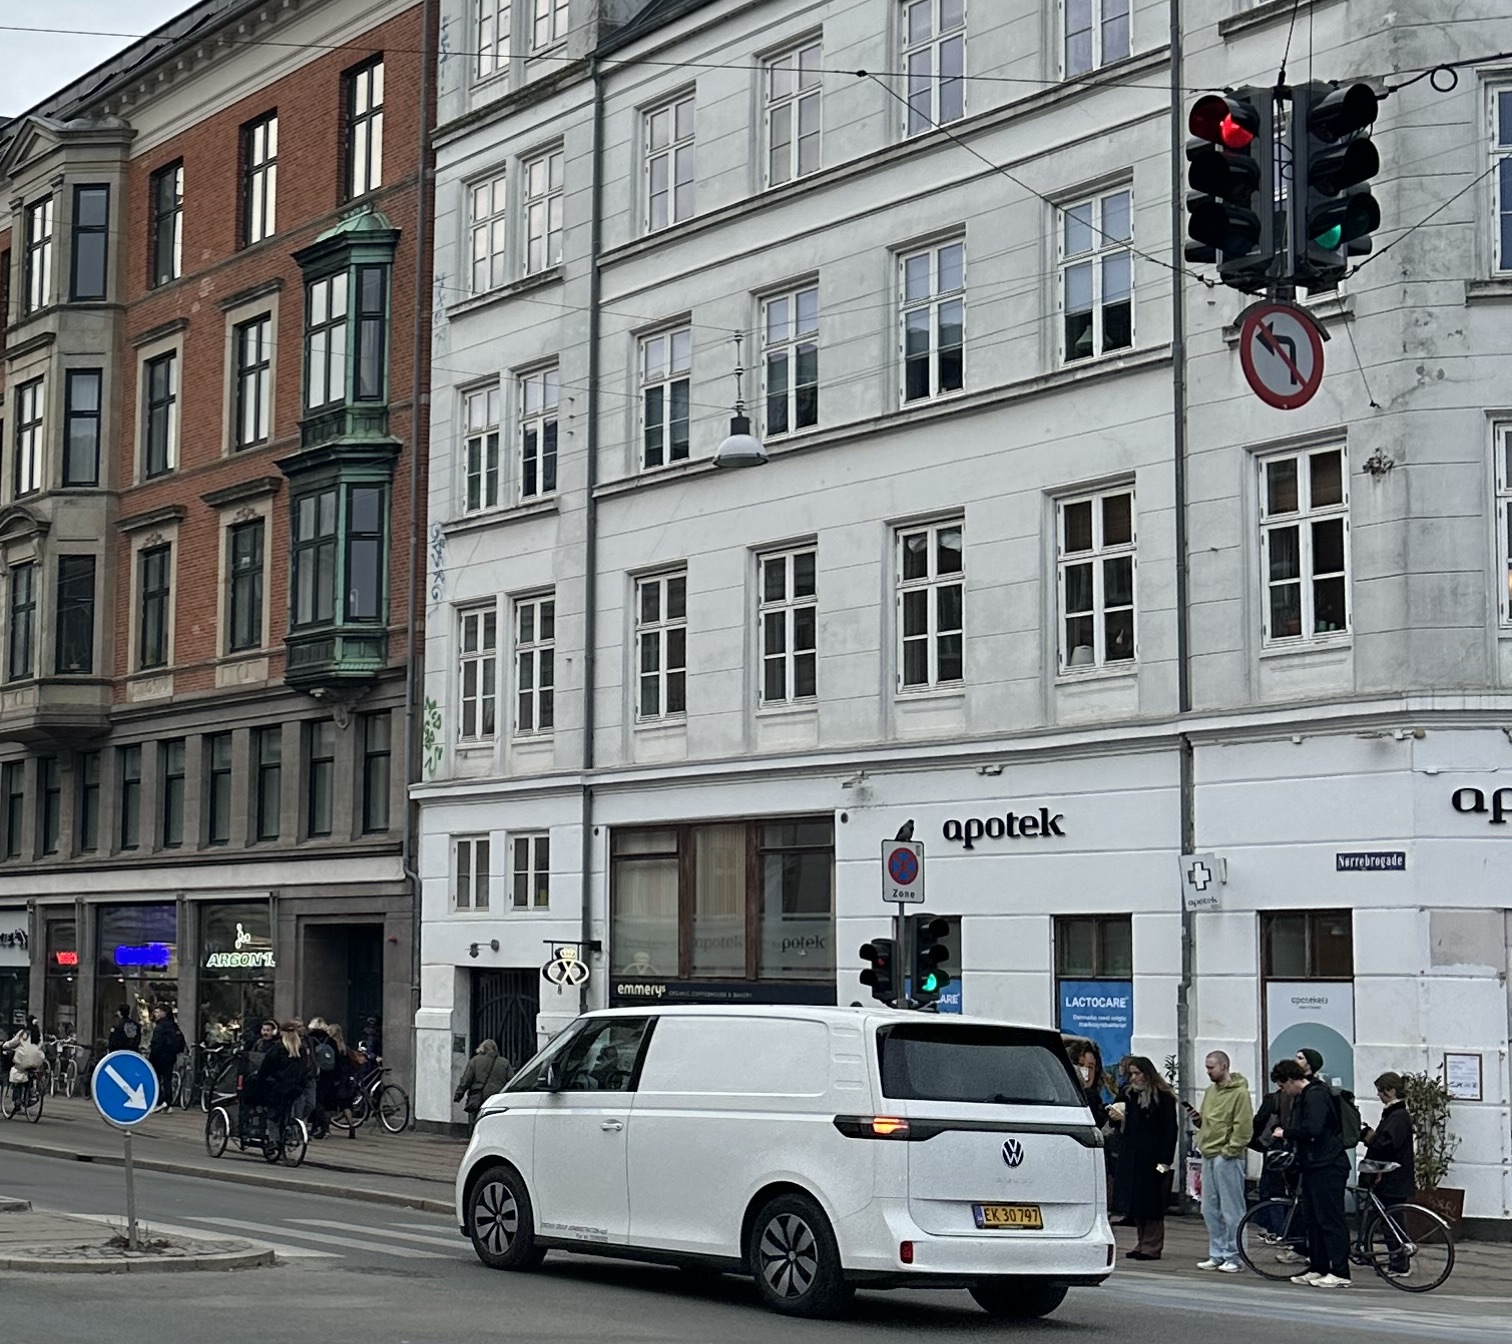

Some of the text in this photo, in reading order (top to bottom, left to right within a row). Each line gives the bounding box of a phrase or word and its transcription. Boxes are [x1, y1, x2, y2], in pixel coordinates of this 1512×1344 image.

[943, 807, 1065, 849] apotek
[1339, 854, 1403, 868] Nørrebrogade
[893, 889, 915, 899] Zone
[1188, 896, 1218, 906] apotek
[206, 953, 262, 968] ARGON
[1065, 996, 1127, 1008] LACTOCARE
